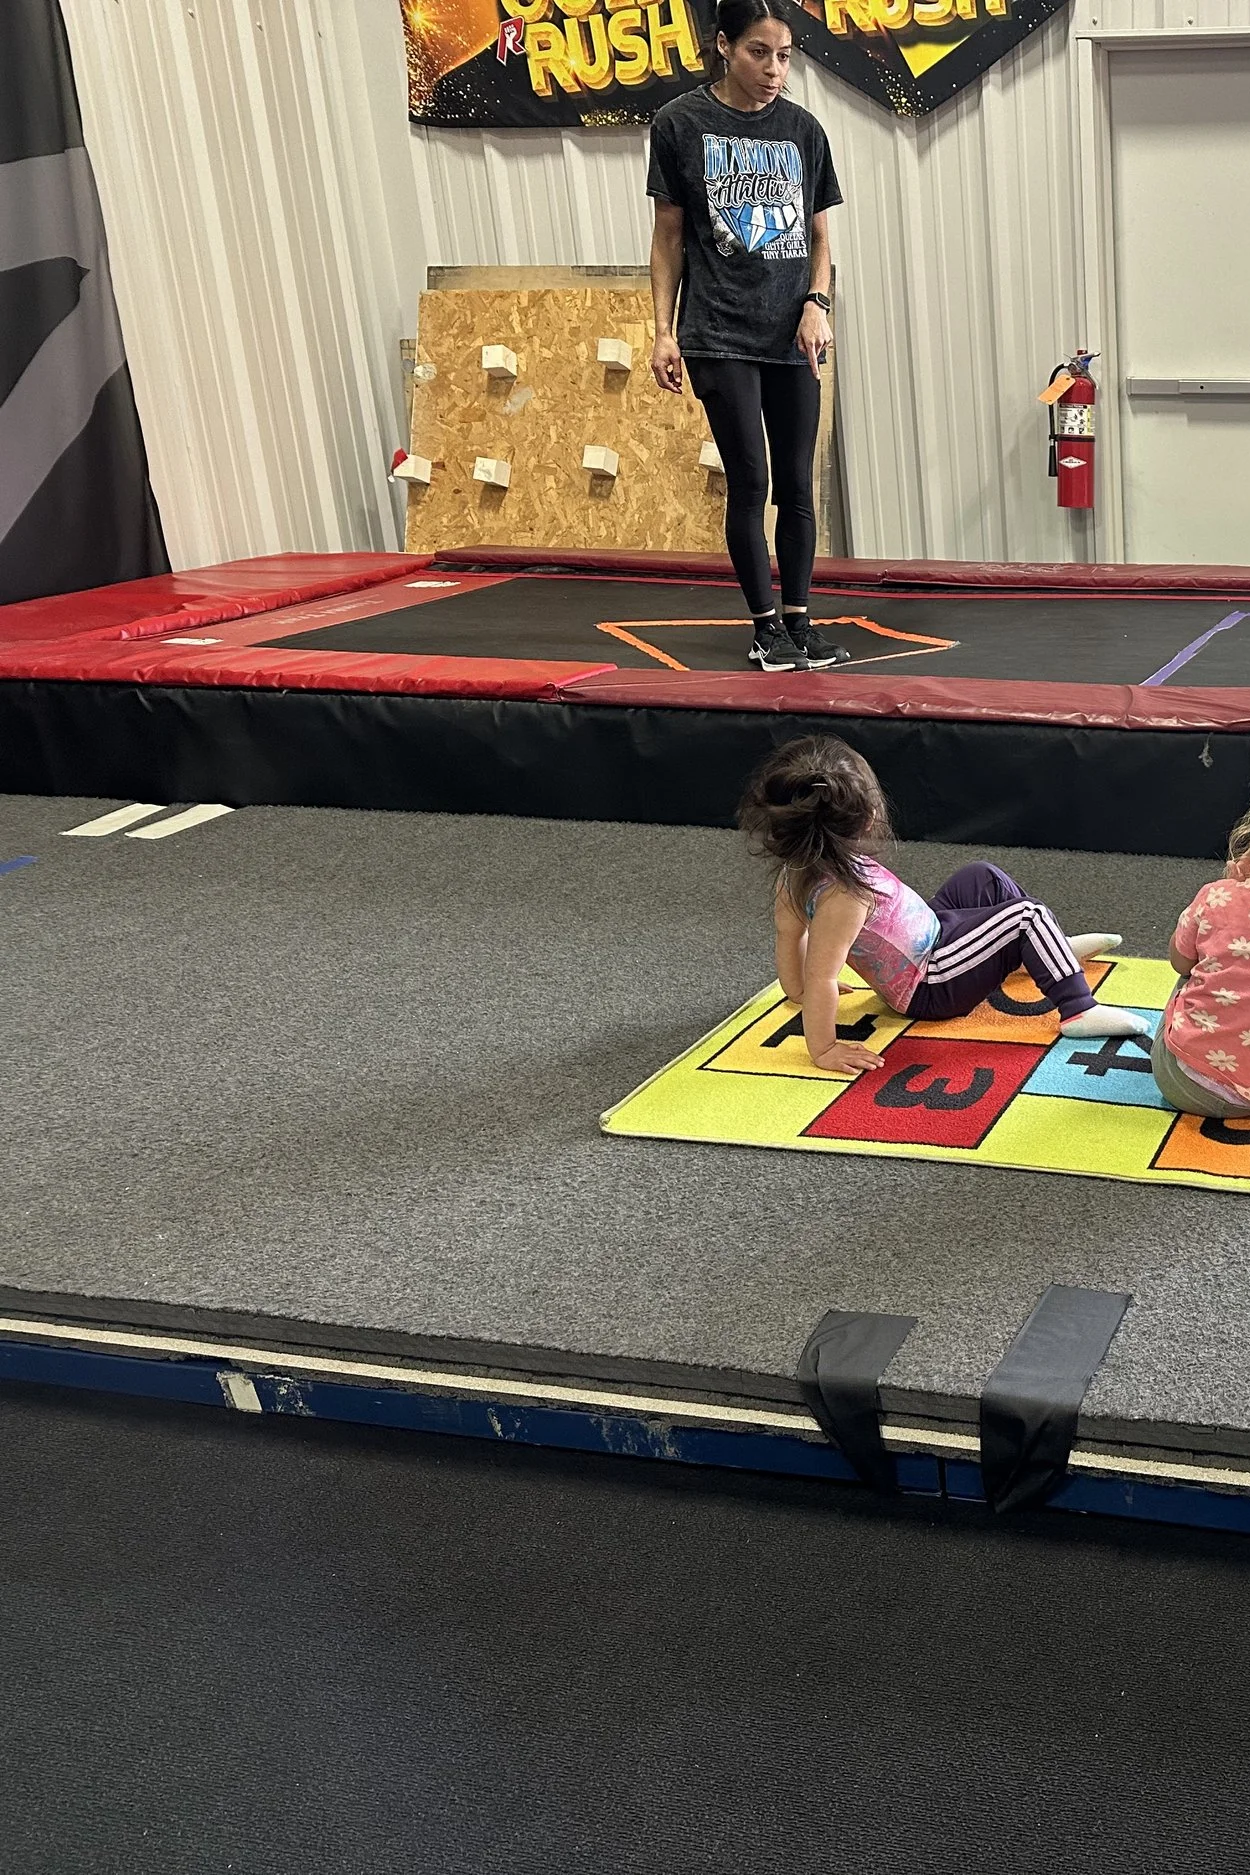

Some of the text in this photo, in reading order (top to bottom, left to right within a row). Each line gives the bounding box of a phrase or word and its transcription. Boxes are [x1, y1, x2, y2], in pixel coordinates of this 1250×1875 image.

[525, 0, 704, 97] RUSH
[702, 134, 802, 189] DIAMOND
[709, 174, 794, 208] Athletics
[761, 249, 808, 260] TINY TIARAS
[874, 1063, 994, 1110] 3
